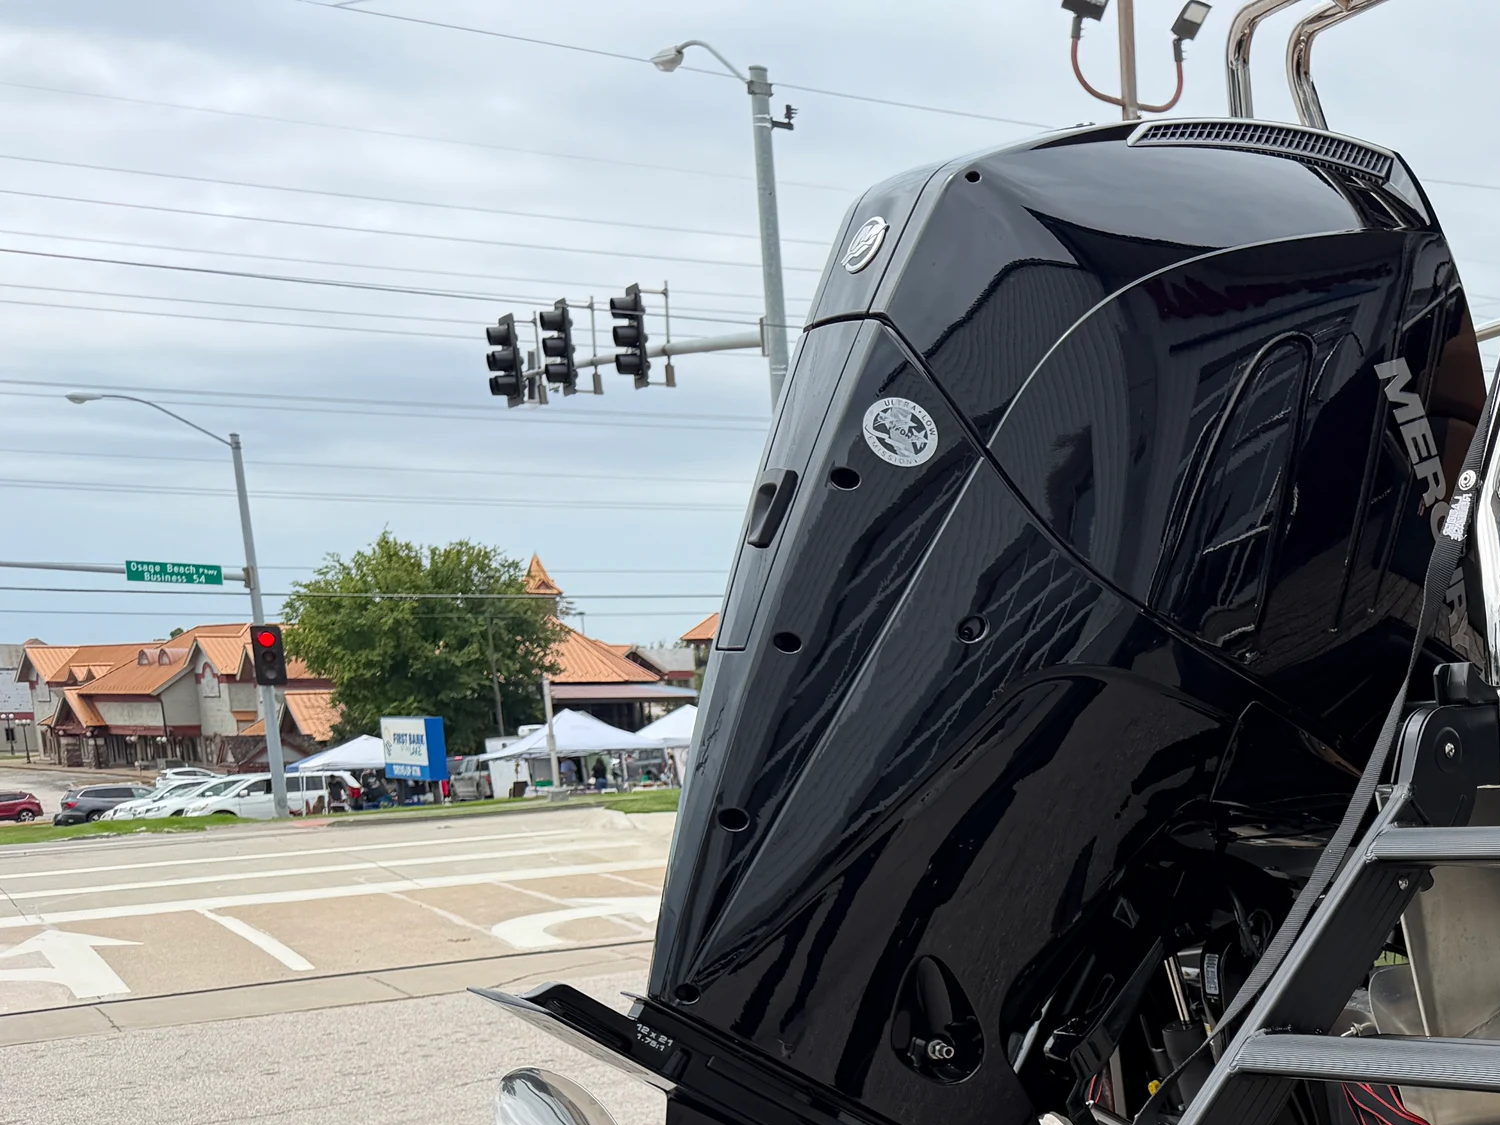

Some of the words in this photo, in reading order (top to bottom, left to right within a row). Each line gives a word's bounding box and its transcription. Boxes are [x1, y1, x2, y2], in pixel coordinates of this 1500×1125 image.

[921, 414, 936, 436] LOW
[130, 562, 160, 574] Osage
[166, 563, 196, 574] Beach
[144, 571, 187, 583] Business
[193, 574, 206, 584] 54
[393, 733, 408, 745] FIRST
[637, 1023, 650, 1035] 12
[658, 1035, 673, 1047] 21
